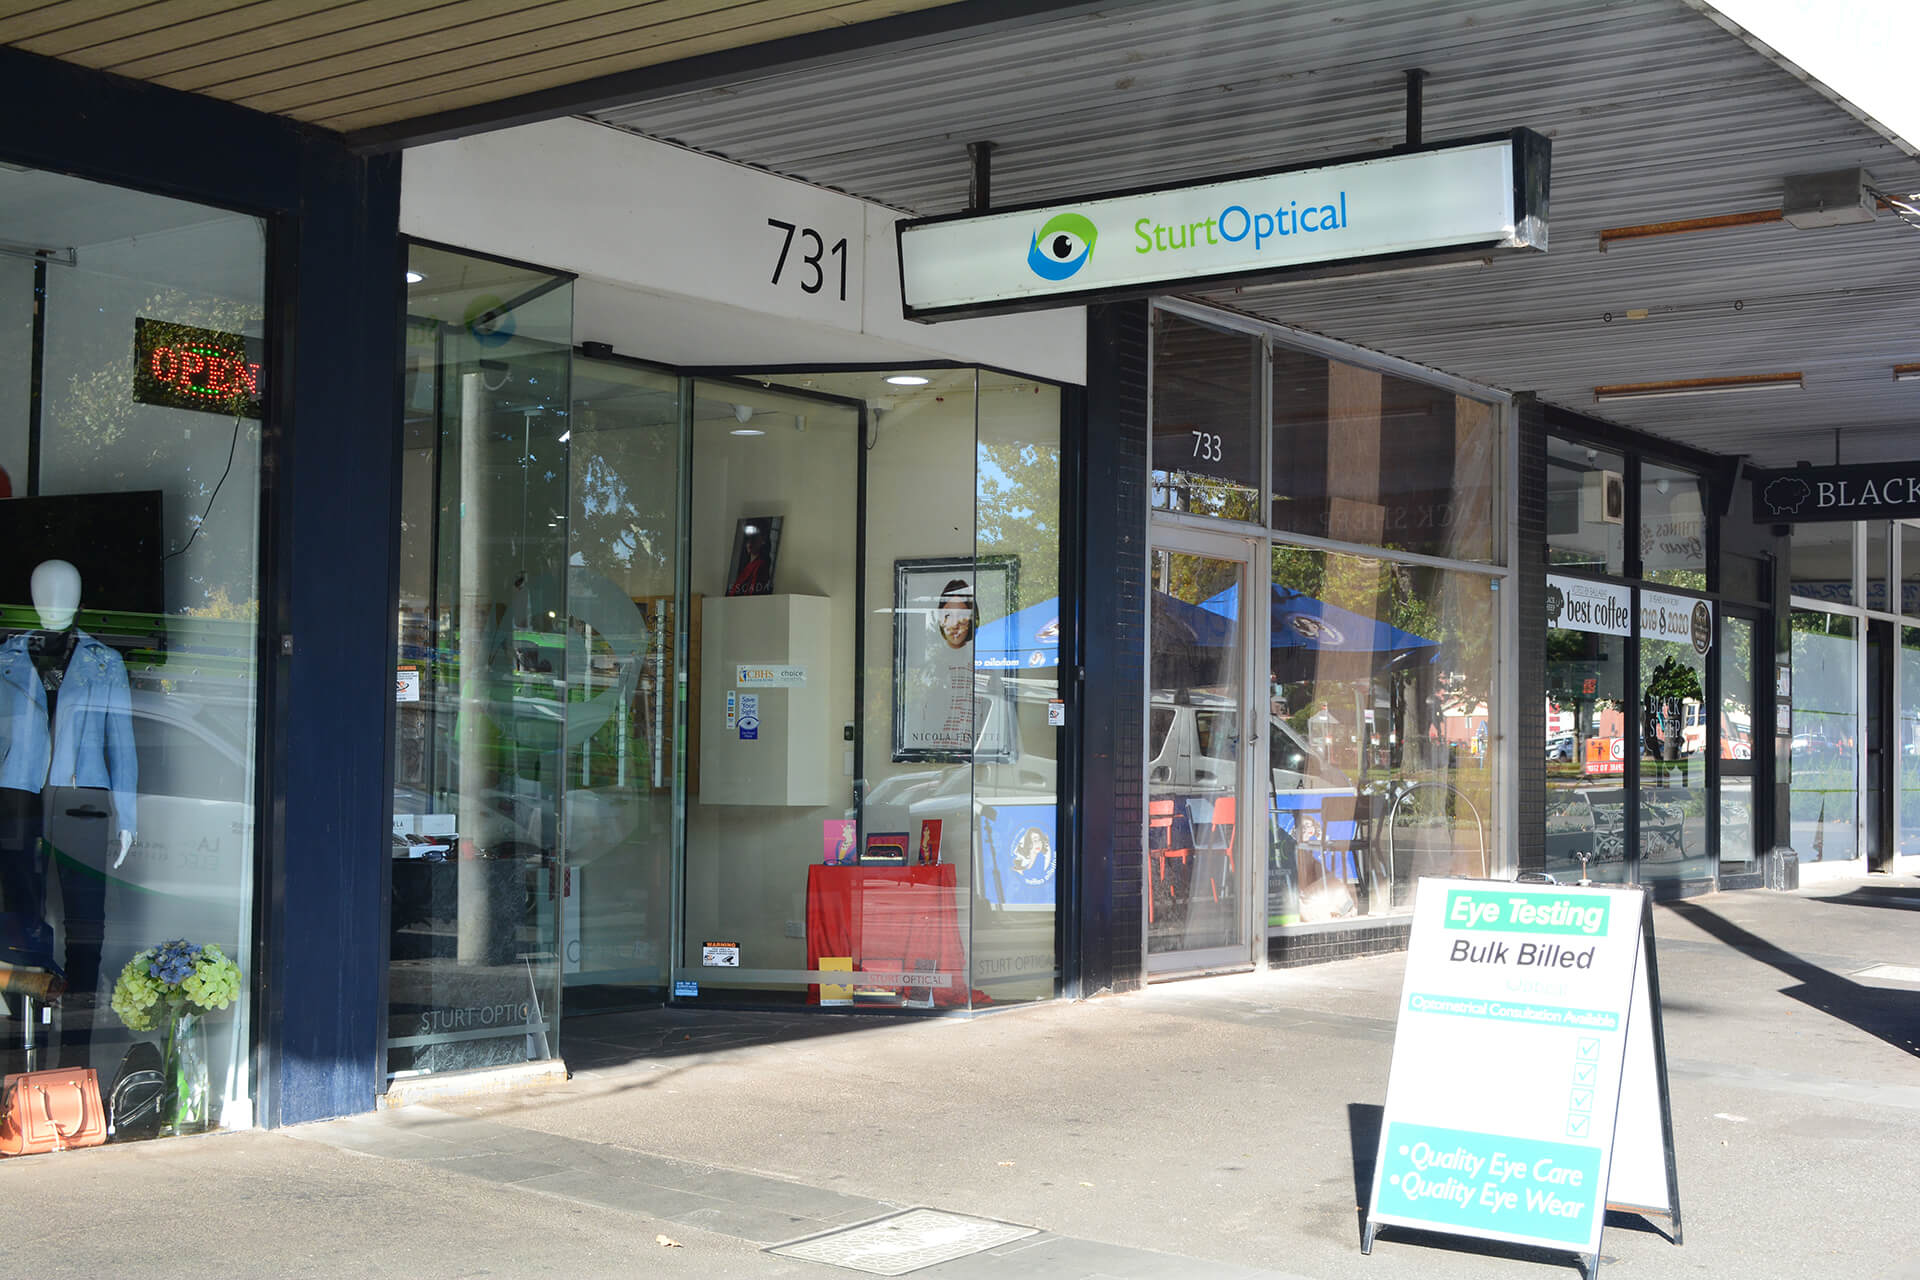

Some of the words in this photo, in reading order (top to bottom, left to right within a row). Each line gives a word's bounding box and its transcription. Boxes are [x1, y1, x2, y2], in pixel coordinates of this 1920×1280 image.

[767, 217, 847, 302] 731
[151, 346, 261, 395] OPEN
[1192, 430, 1222, 462] 733
[1816, 477, 1920, 508] BLACK
[1566, 590, 1591, 624] best
[1594, 596, 1629, 630] coffee
[1667, 612, 1689, 635] 2020
[747, 669, 774, 679] CBHS
[1649, 695, 1681, 716] BLACK
[912, 732, 950, 742] NICOLA
[1450, 895, 1500, 928] Eye
[1508, 897, 1604, 934] Testing
[979, 957, 1012, 976] STURT
[1449, 939, 1510, 965] Bulk
[1516, 942, 1596, 969] Billed
[869, 974, 900, 985] STURT
[902, 975, 944, 986] OPTICAL
[421, 1007, 476, 1032] STURT
[480, 1001, 549, 1025] OPTICAL
[1411, 994, 1489, 1015] Optometrical
[1411, 1142, 1486, 1179] Quality
[1488, 1151, 1527, 1183] Eye
[1532, 1158, 1584, 1187] Care
[1401, 1171, 1476, 1209] Quality
[1479, 1182, 1518, 1214] Eye
[1525, 1188, 1585, 1219] Wear
